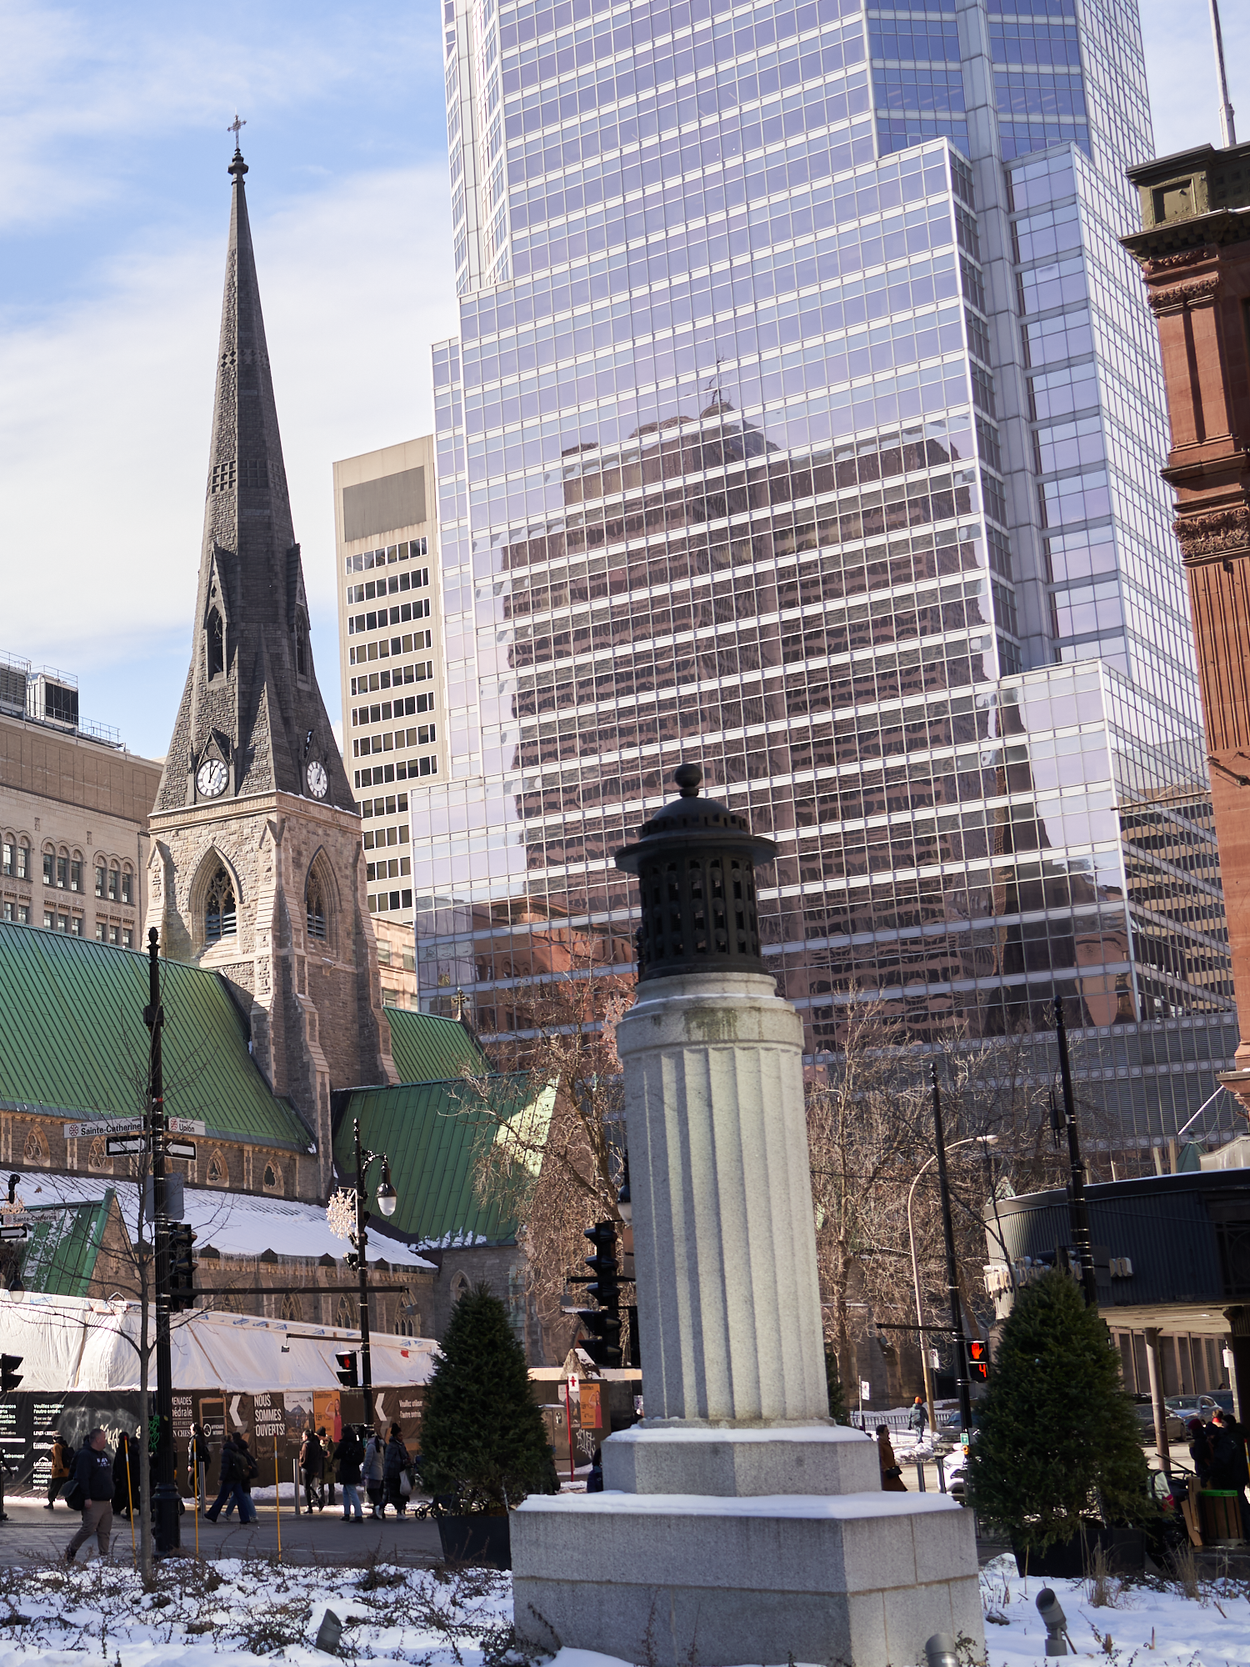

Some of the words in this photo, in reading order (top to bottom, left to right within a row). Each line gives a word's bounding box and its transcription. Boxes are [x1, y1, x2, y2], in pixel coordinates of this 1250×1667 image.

[81, 1123, 142, 1136] Sainte-Catherine
[179, 1123, 195, 1132] Union
[978, 1363, 987, 1378] 4
[253, 1394, 271, 1407] NOUS
[254, 1408, 282, 1422] SOMMES
[255, 1423, 286, 1437] OUVERTS!
